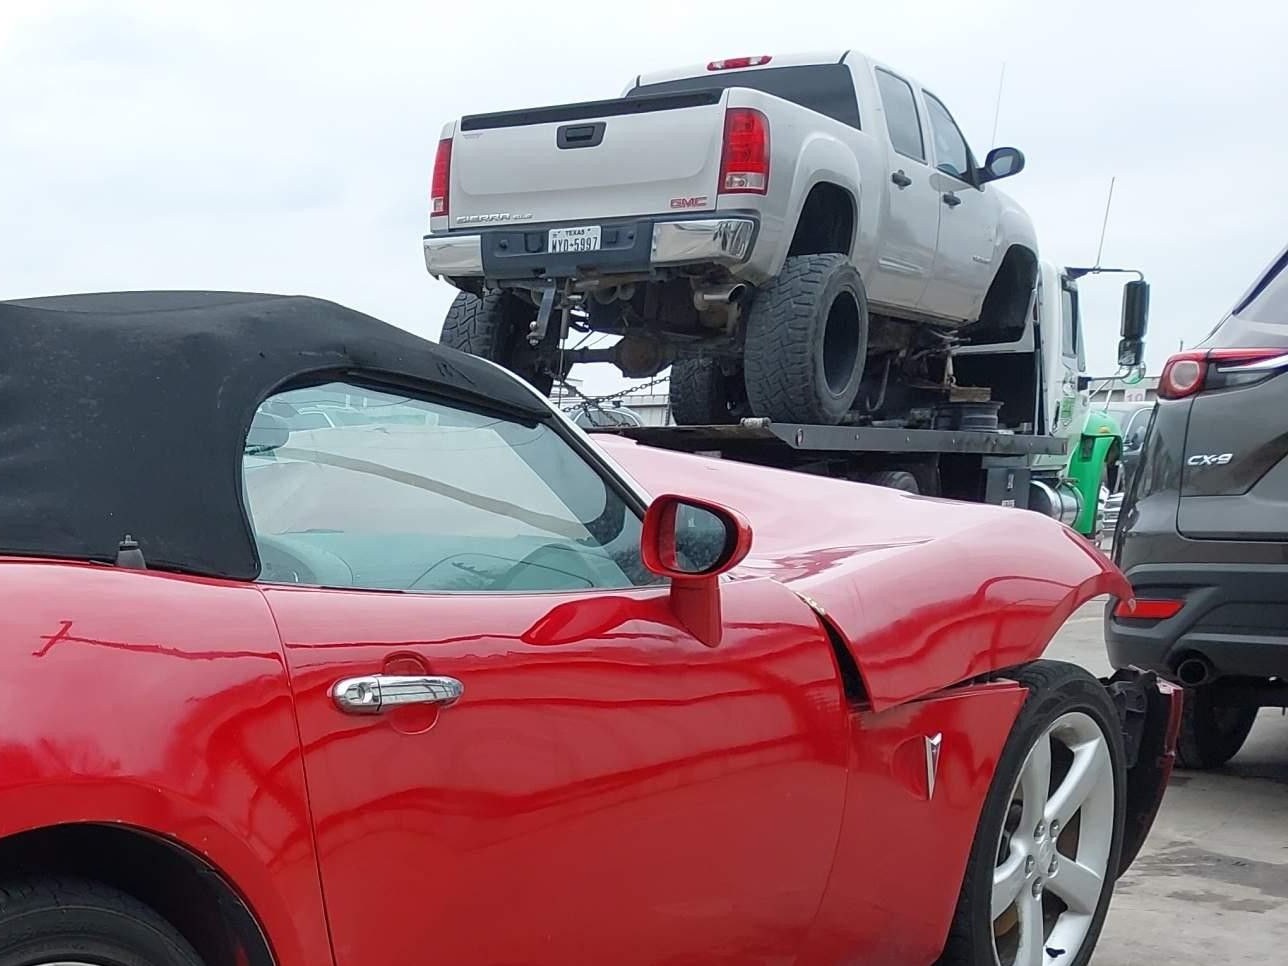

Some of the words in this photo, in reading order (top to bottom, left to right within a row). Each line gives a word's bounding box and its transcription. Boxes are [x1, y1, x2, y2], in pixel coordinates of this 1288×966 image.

[670, 196, 707, 208] GMC
[456, 212, 511, 224] SIERRA
[1187, 453, 1233, 466] CX-9
